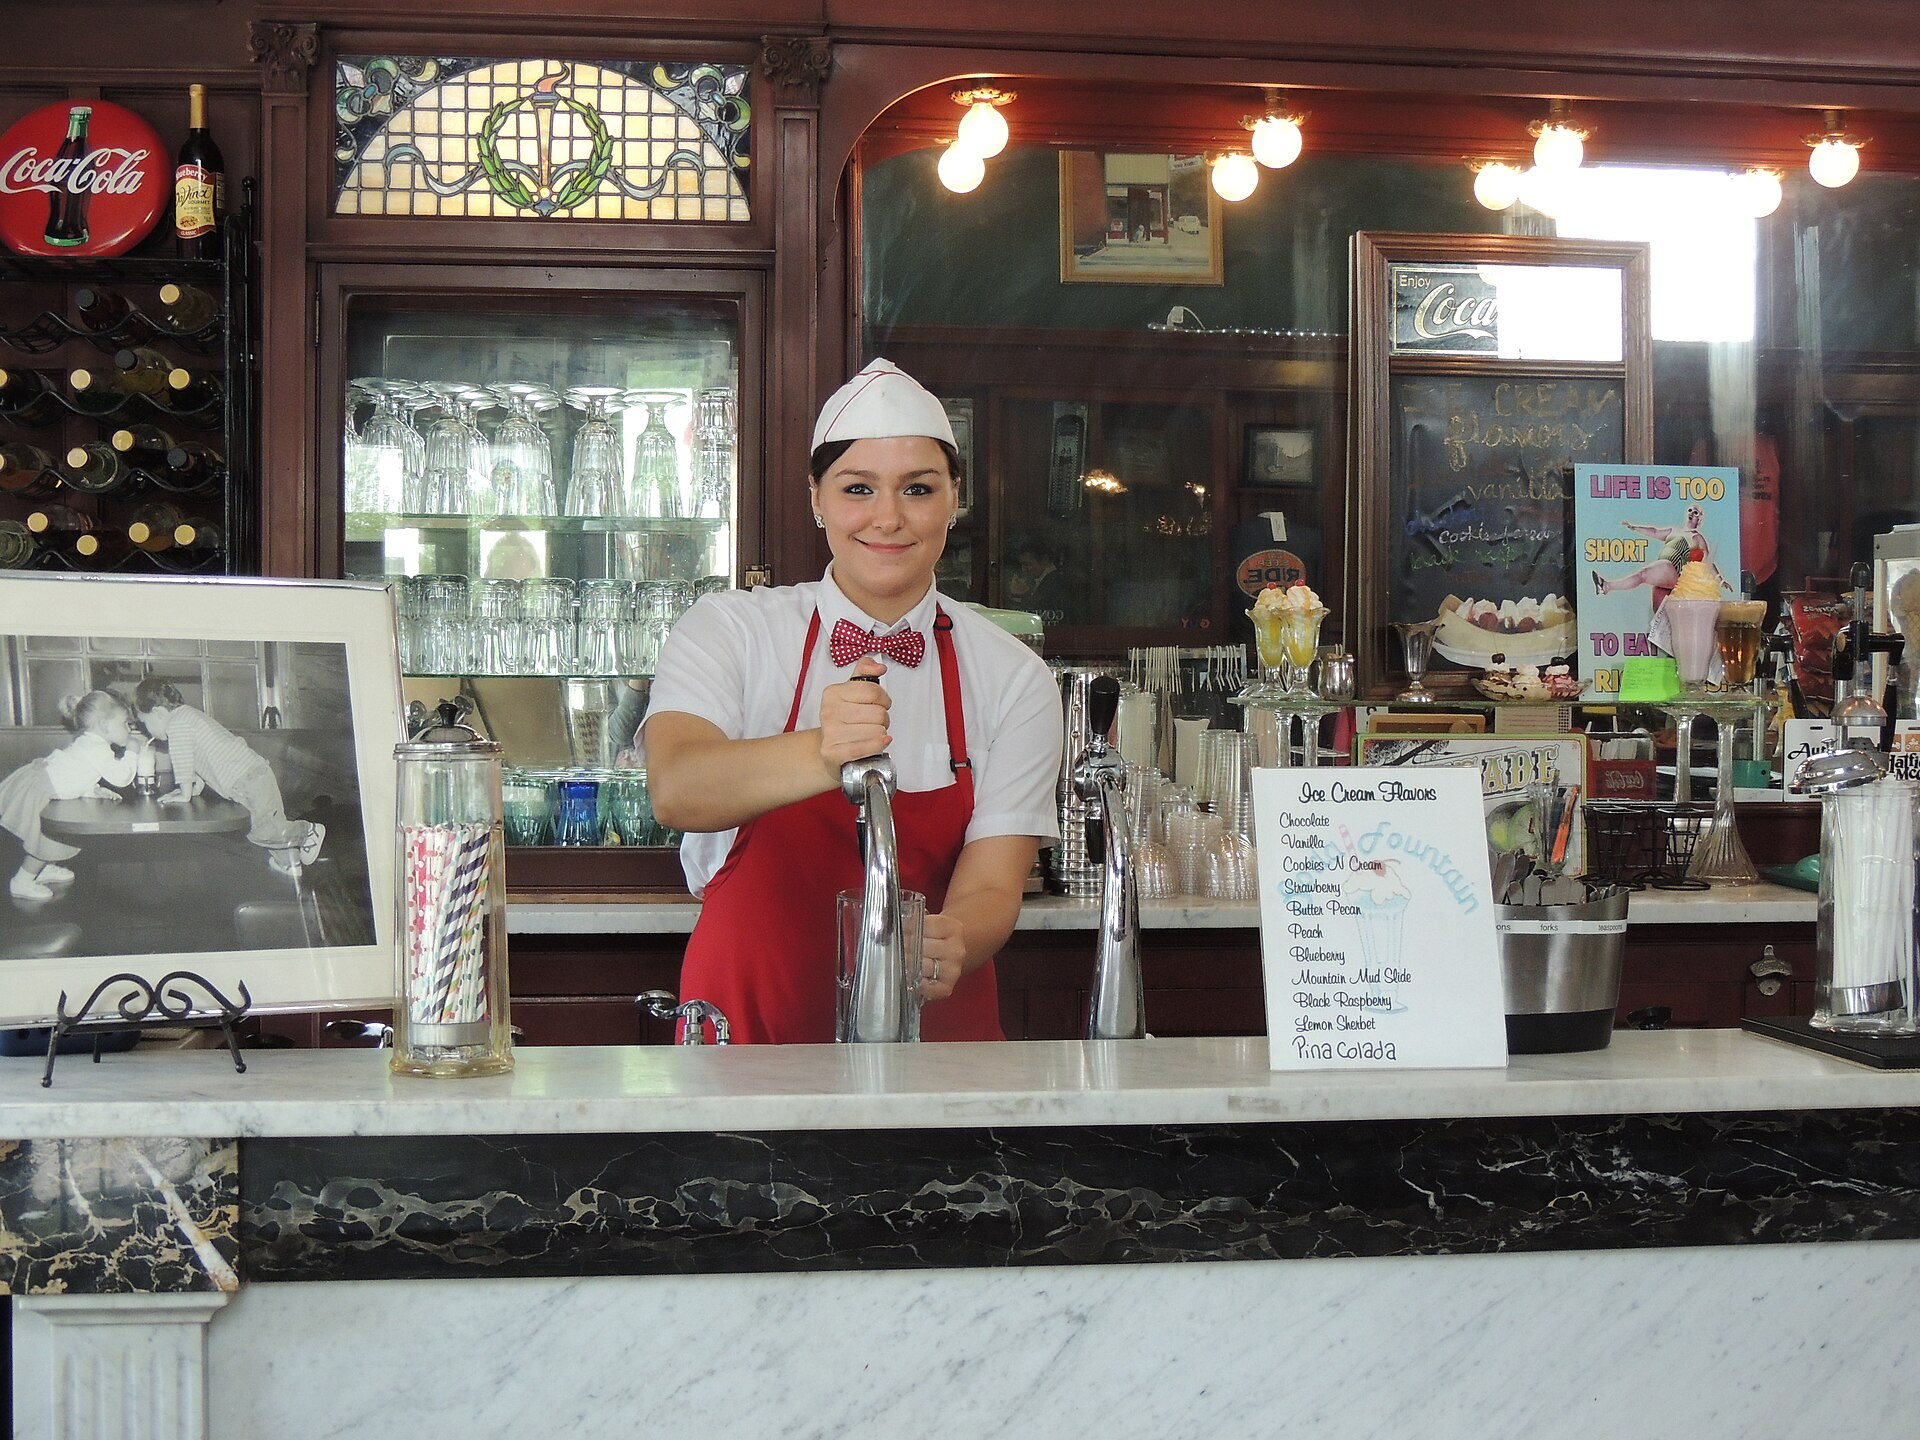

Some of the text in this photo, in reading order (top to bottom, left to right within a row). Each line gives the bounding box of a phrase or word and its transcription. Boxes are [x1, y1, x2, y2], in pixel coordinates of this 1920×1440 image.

[0, 147, 150, 195] Coca-Cola
[1399, 274, 1430, 289] Enjoy
[1589, 474, 1641, 499] LIFE
[1646, 476, 1671, 499] IS
[1674, 476, 1725, 501] TOO
[1584, 538, 1648, 562] SHORT
[1589, 632, 1619, 656] TO
[1298, 780, 1437, 804] Ice Cream Flavors
[1279, 811, 1330, 829] Chocolate
[1281, 834, 1324, 849] Vanilla
[1282, 855, 1383, 873] Cookies N Cream
[1284, 879, 1341, 897] Strawberry
[1286, 900, 1362, 916] Butter Pecan
[1287, 923, 1324, 939] Peach
[1540, 924, 1559, 932] forks
[1289, 946, 1346, 966] Blueberry
[1291, 967, 1412, 986] Mountain Mud Slide
[1292, 991, 1392, 1011] Black Raspberry
[1294, 1014, 1376, 1033] Lemon Sherbet
[1291, 1035, 1397, 1061] Pina Colada
